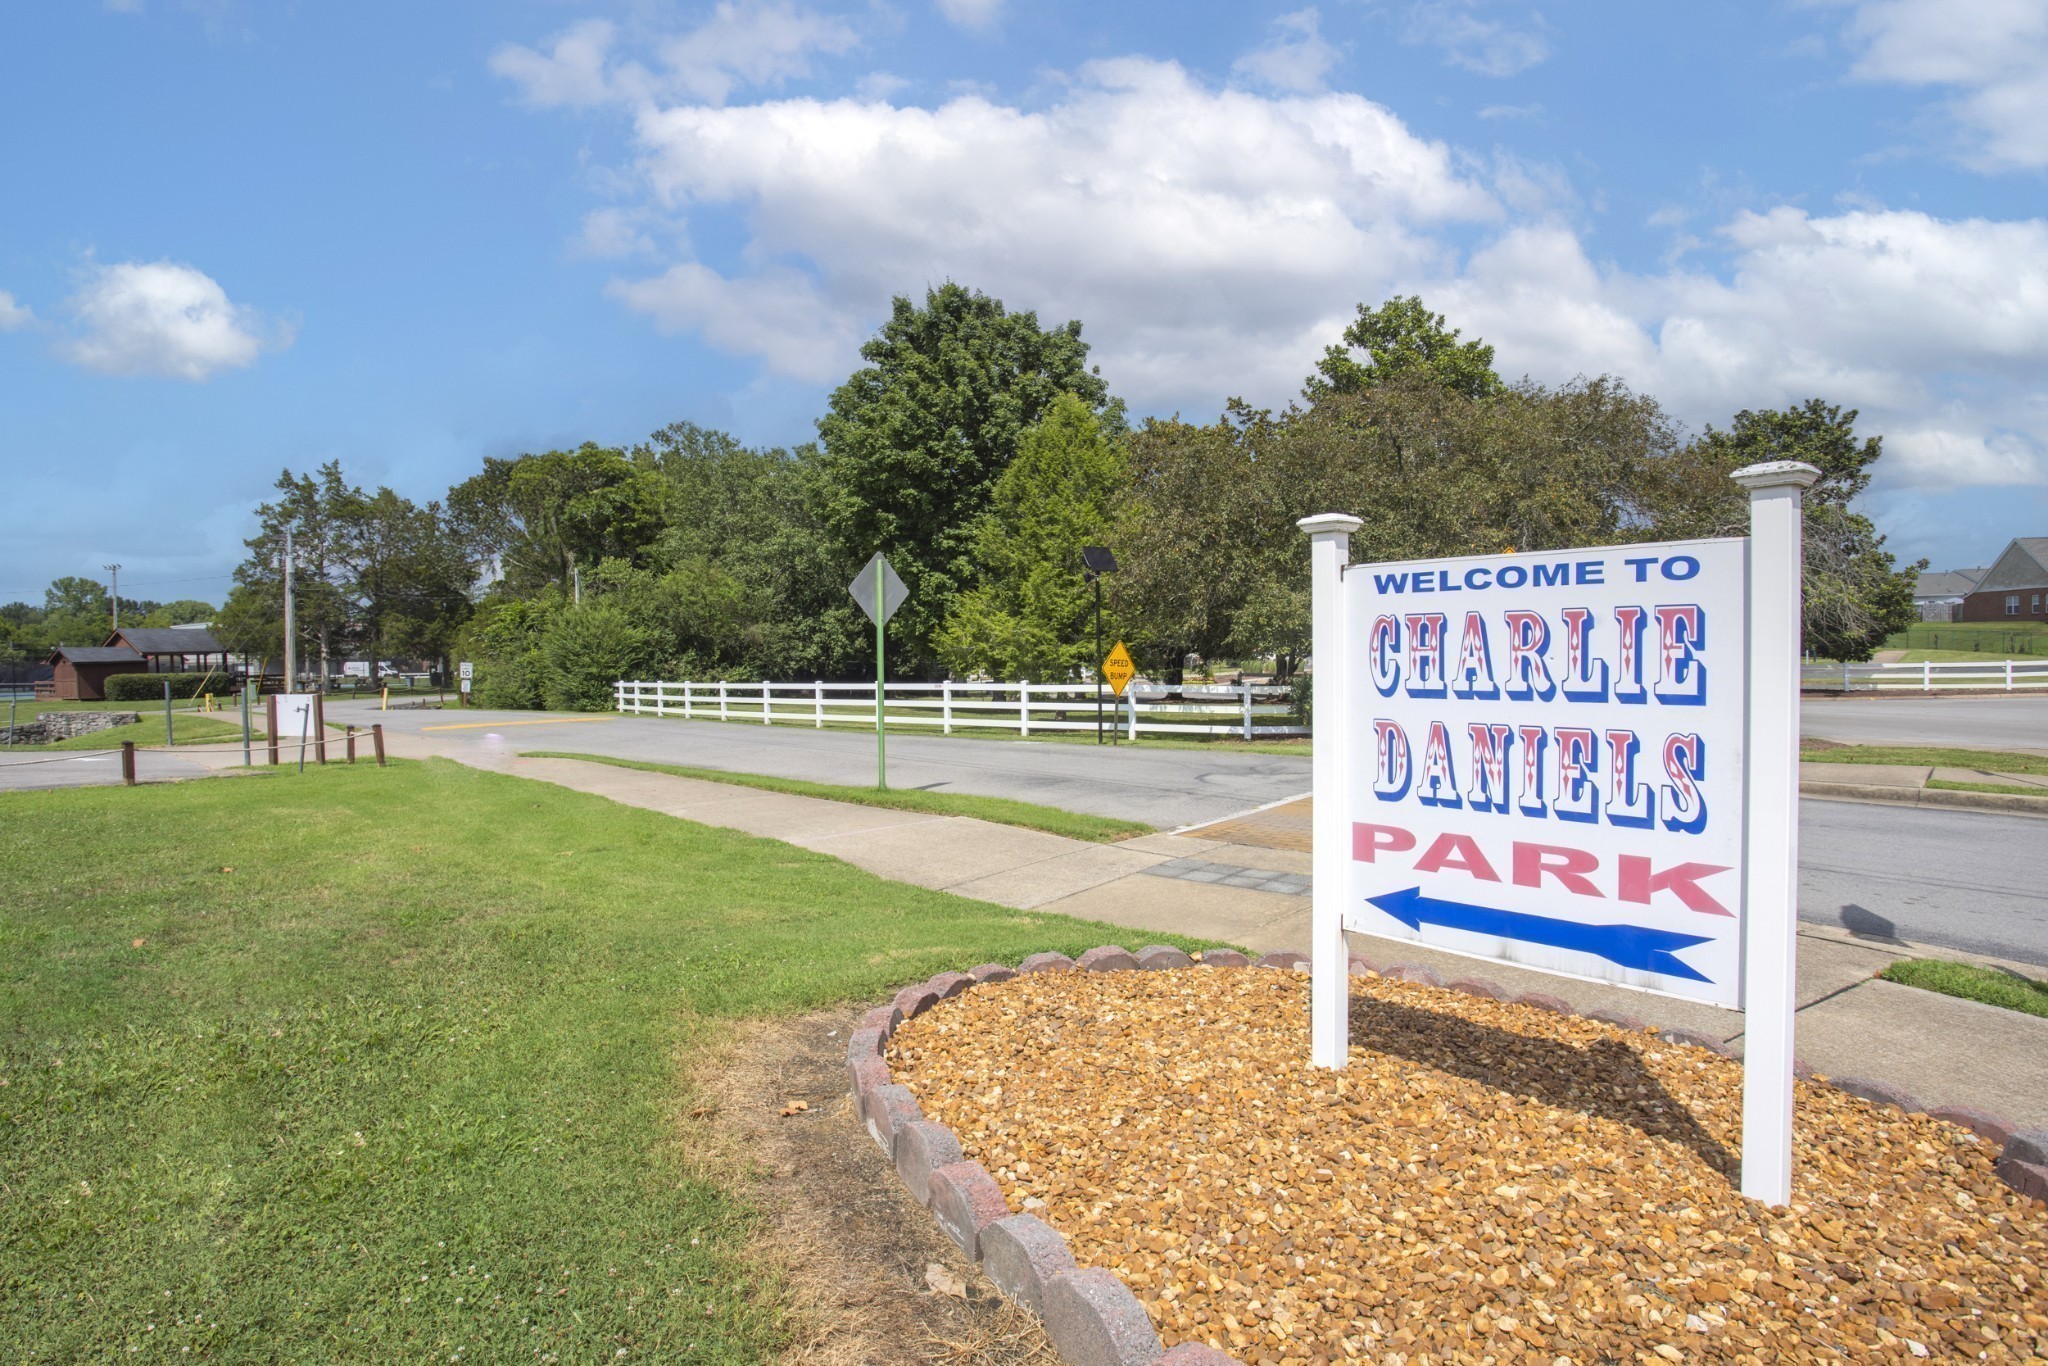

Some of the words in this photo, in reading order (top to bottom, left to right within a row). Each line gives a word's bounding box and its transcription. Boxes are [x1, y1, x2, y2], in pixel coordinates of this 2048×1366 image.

[1374, 561, 1604, 594] WELCOME
[1625, 555, 1701, 582] TO
[1109, 659, 1129, 667] SPEED
[1110, 672, 1127, 680] BUMP
[1369, 604, 1706, 706] CHARLIE
[1373, 718, 1707, 835] DANIELS
[1352, 821, 1736, 918] PARK
